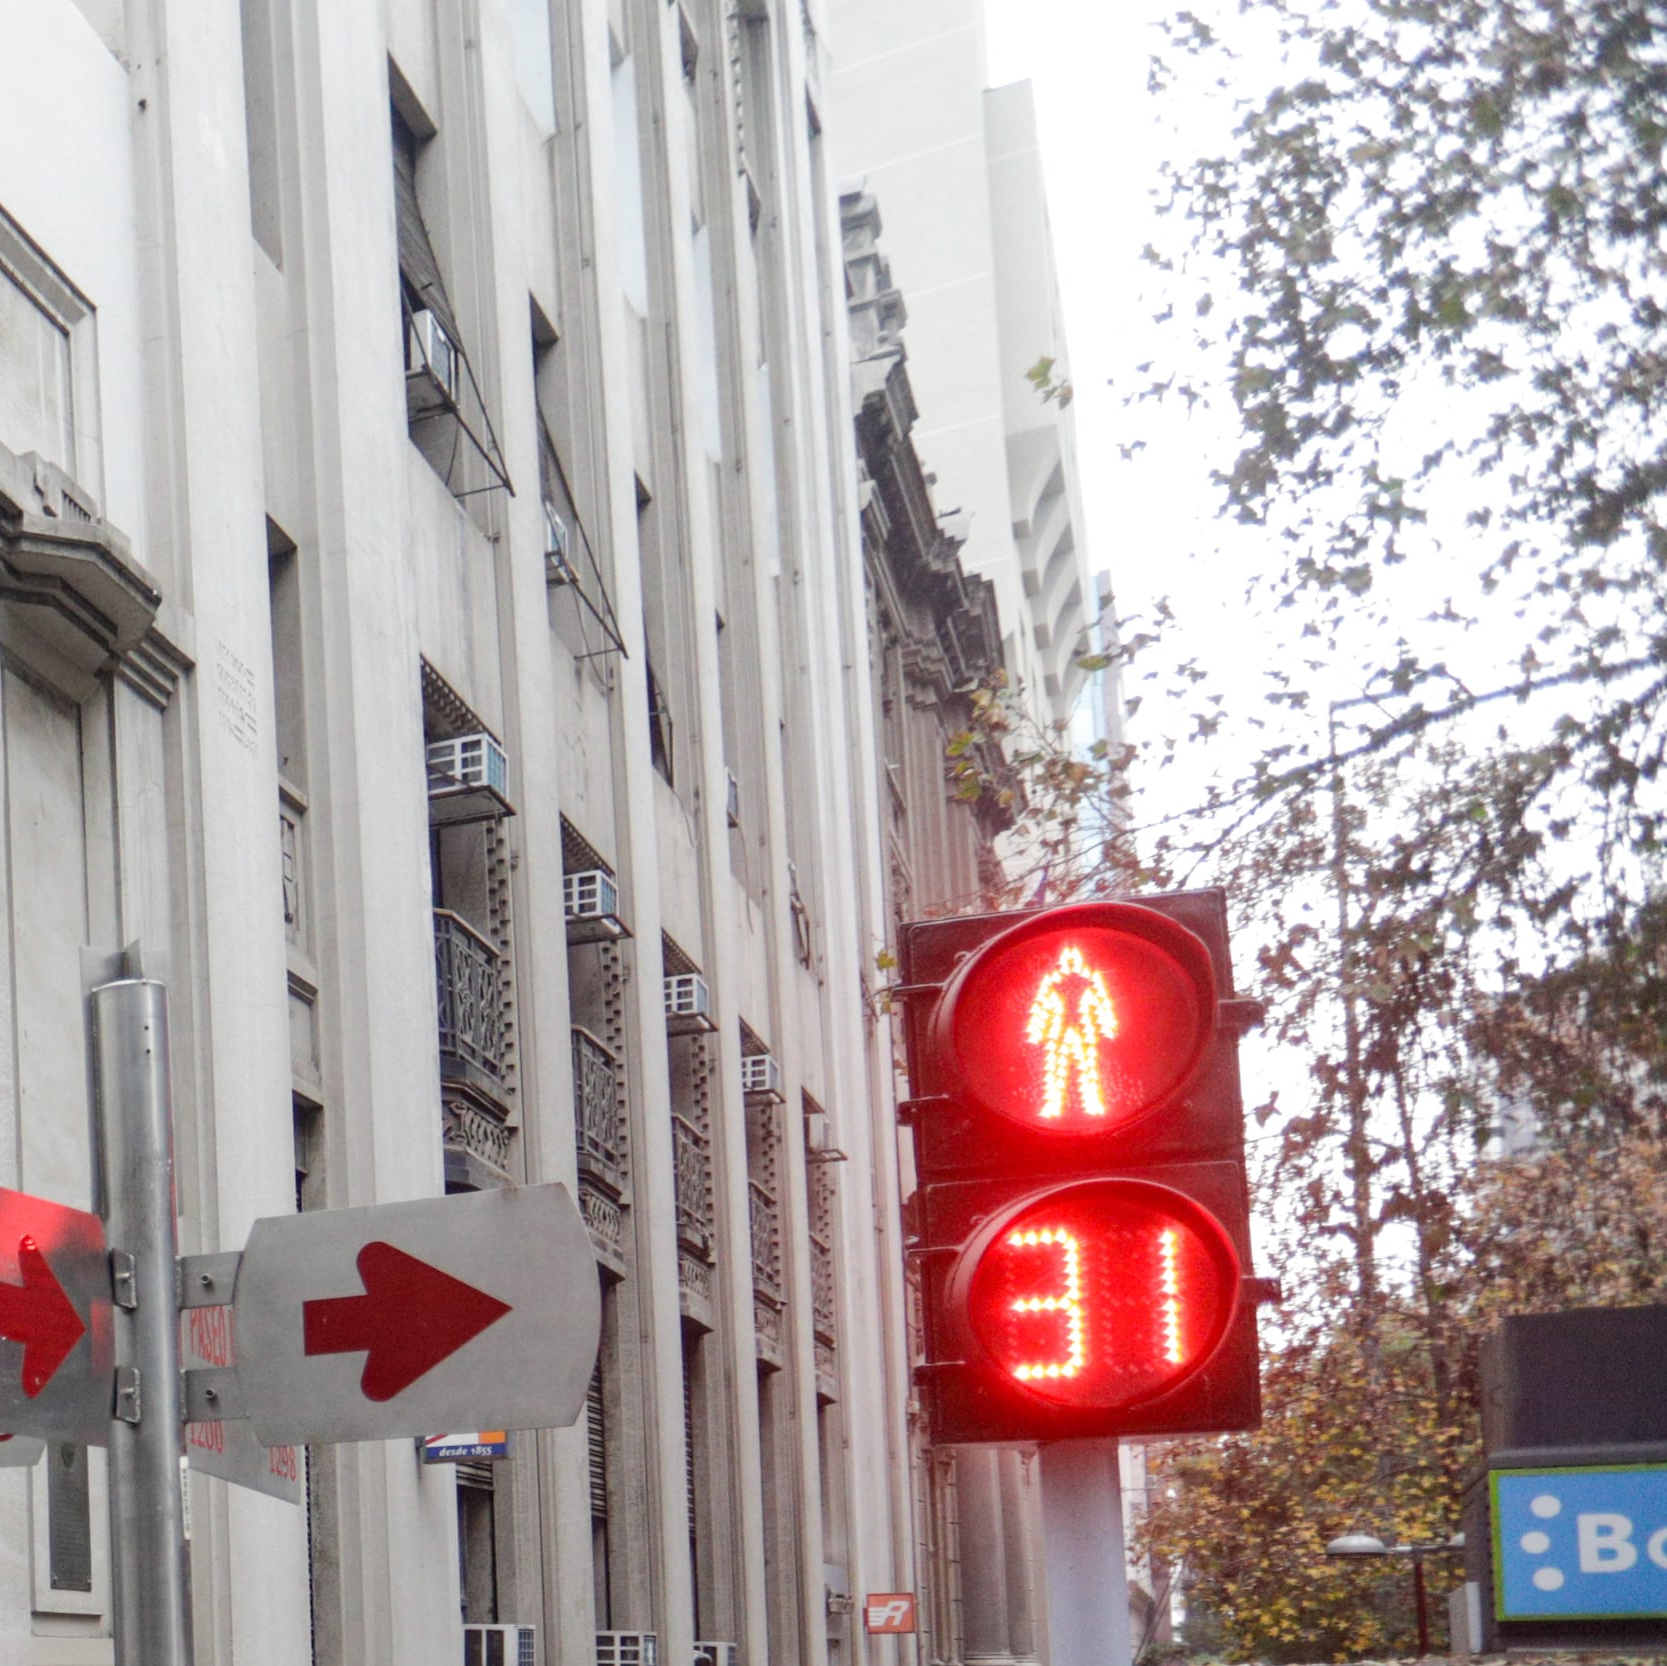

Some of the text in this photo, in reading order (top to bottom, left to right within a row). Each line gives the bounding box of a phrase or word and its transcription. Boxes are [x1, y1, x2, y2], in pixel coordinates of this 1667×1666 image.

[1004, 1226, 1184, 1381] 31
[439, 1445, 493, 1457] desde 1855
